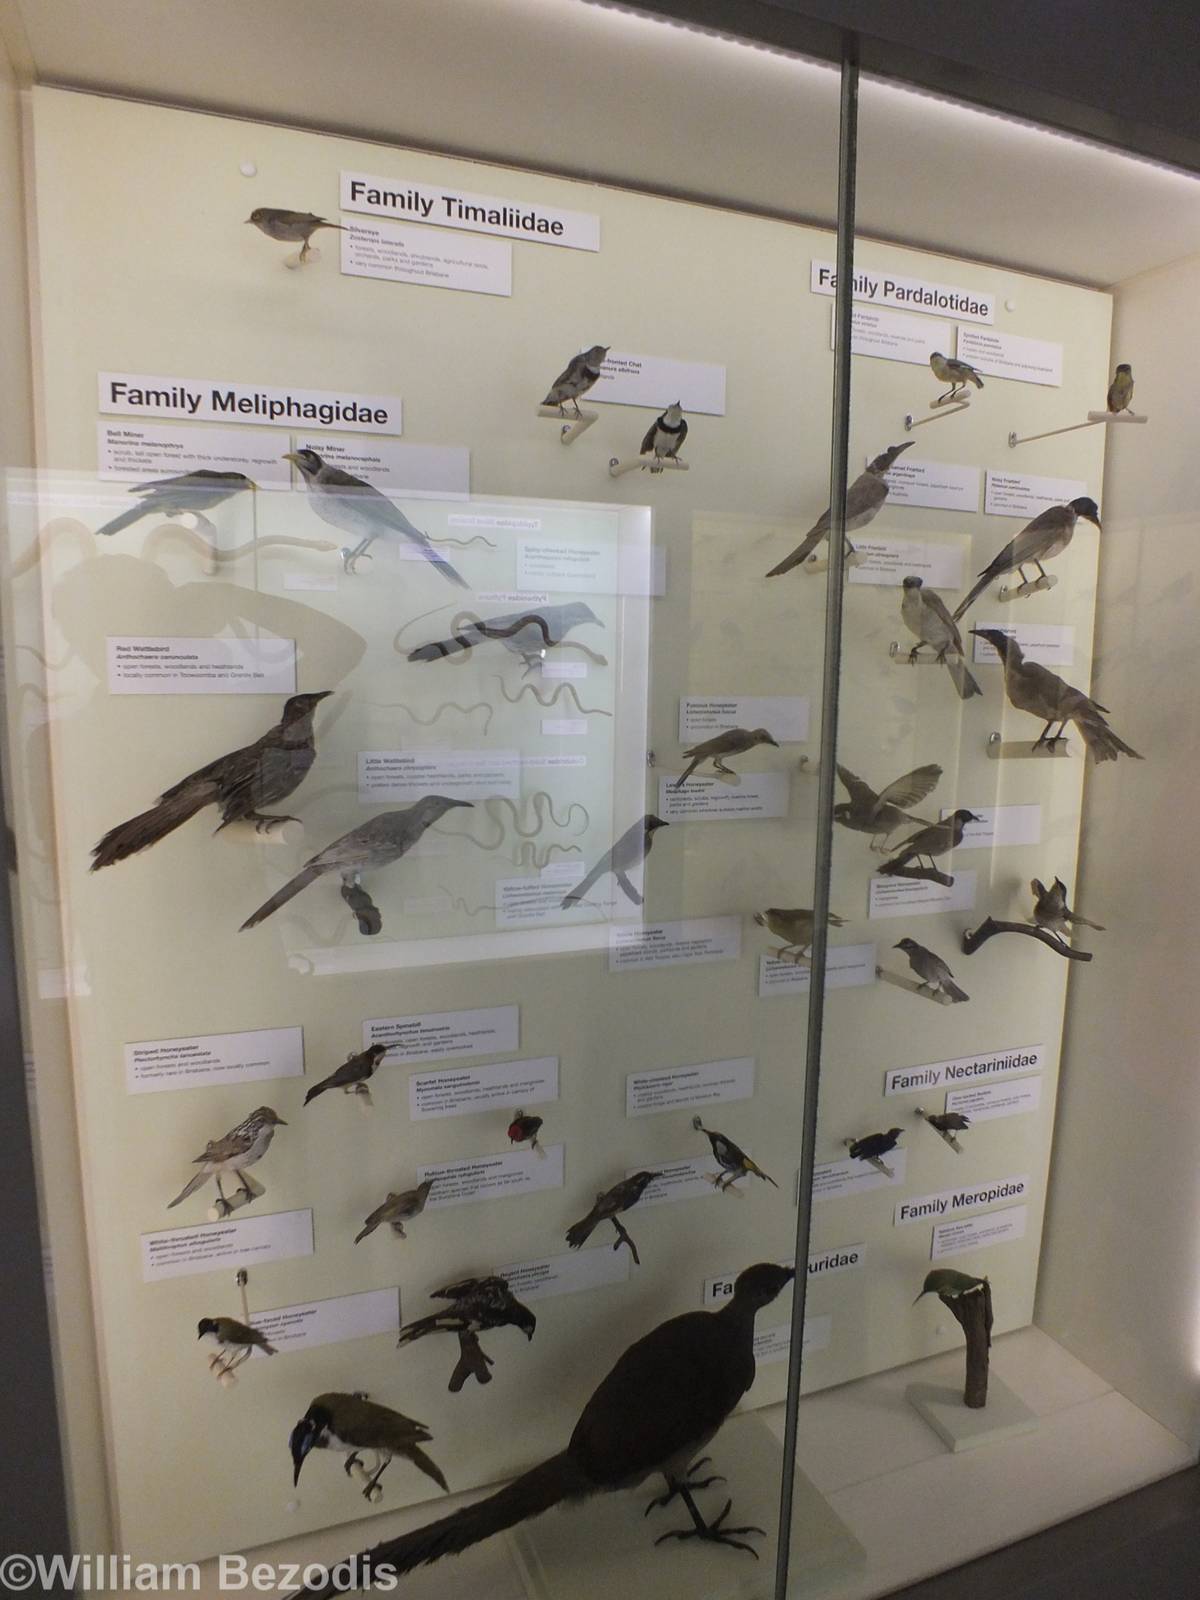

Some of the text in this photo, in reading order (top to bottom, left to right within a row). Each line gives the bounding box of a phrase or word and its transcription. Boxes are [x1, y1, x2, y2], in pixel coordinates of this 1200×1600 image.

[350, 180, 565, 236] Family Timaliidae
[884, 280, 989, 317] Pardalotidae
[110, 382, 389, 425] Family Meliphagidae
[891, 1052, 1038, 1091] Family Nectariniidae
[900, 1181, 1025, 1221] Family Meropidae
